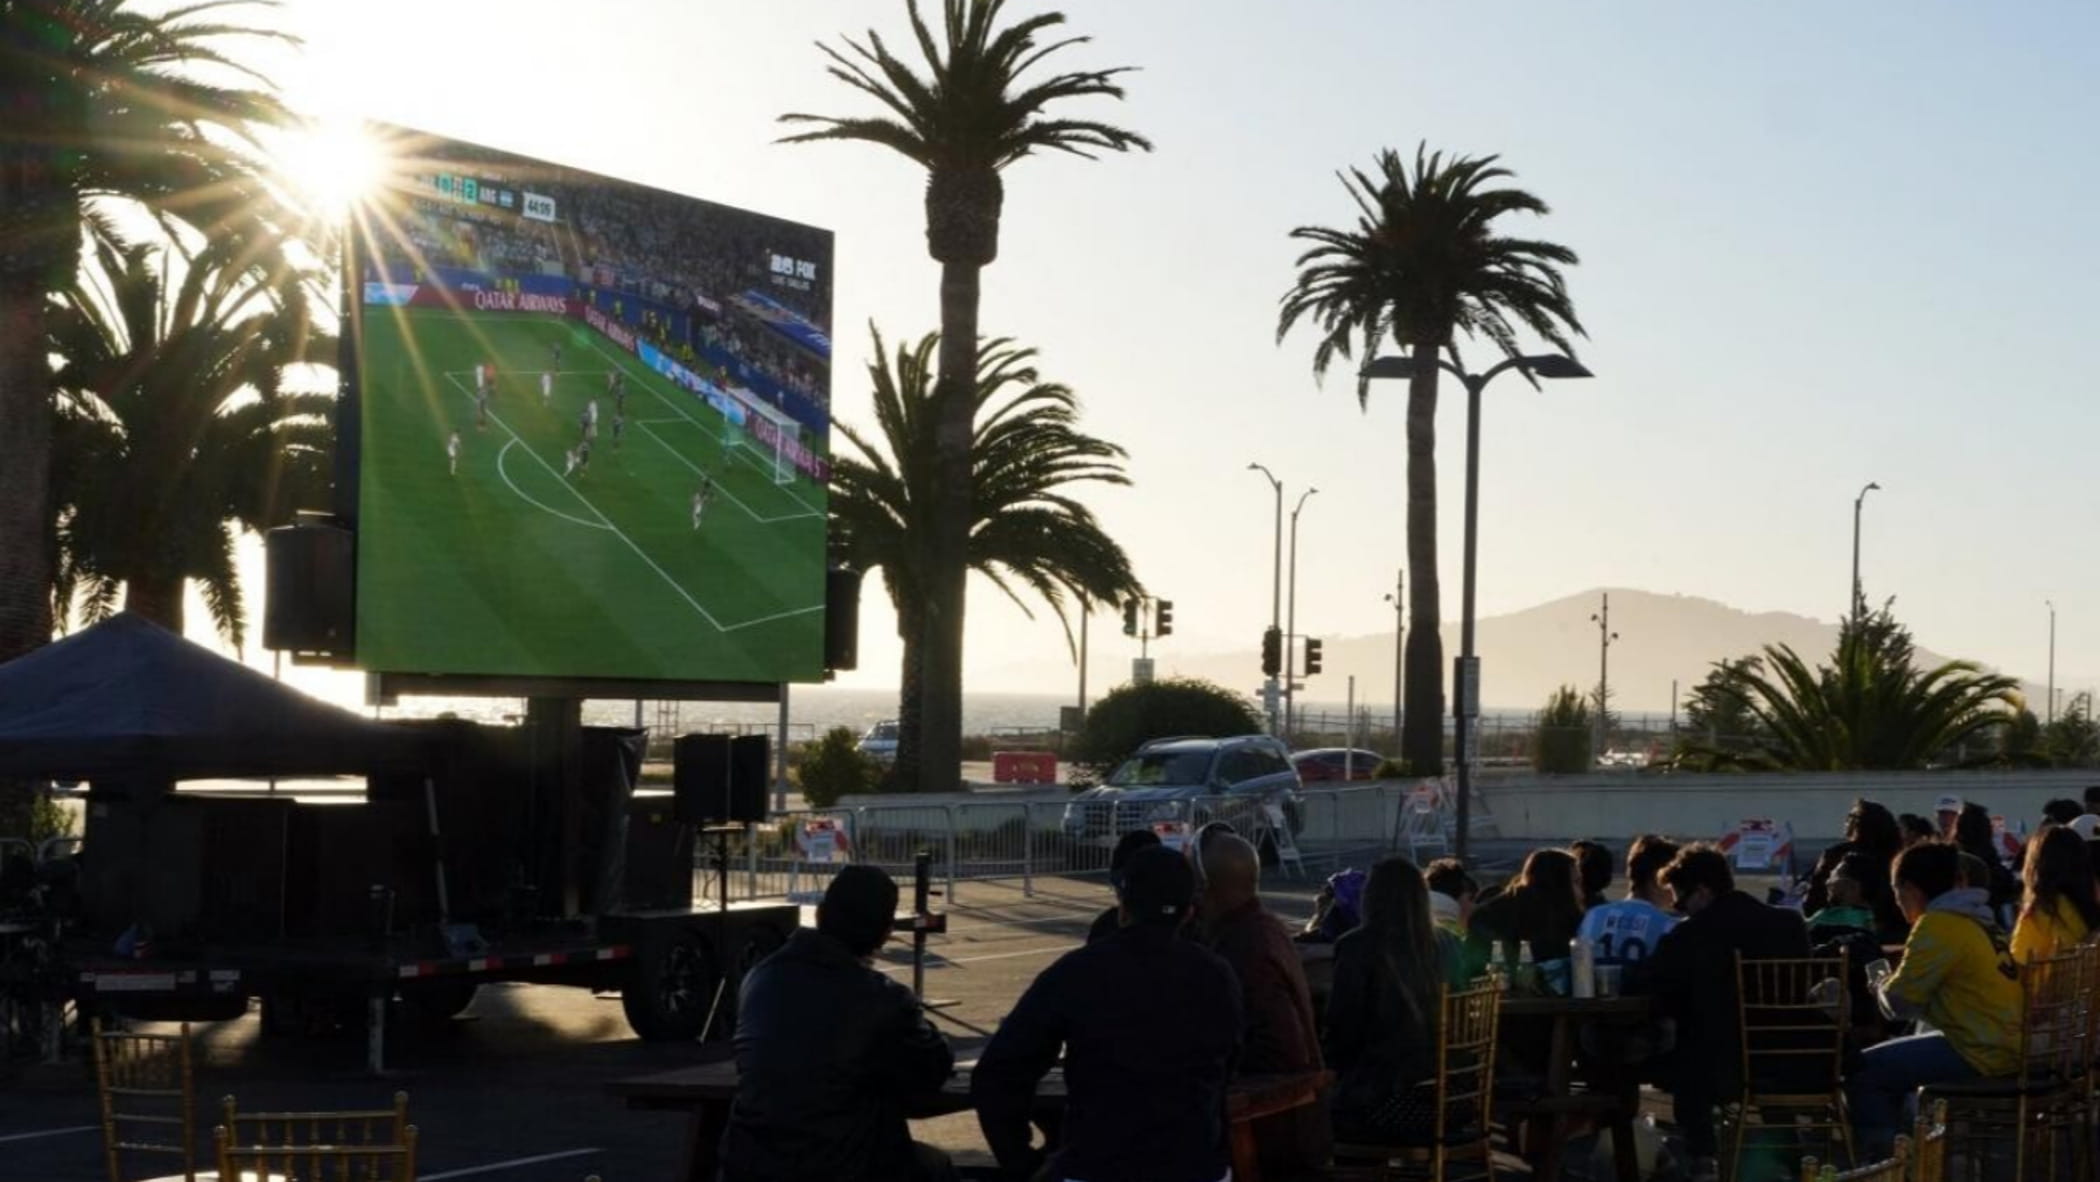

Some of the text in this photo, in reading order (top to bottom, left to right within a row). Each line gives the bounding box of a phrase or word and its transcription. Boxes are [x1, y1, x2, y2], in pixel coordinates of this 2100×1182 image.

[479, 186, 497, 204] ARG
[475, 291, 567, 314] QATAR AIRWAYS
[1600, 933, 1647, 961] 10
